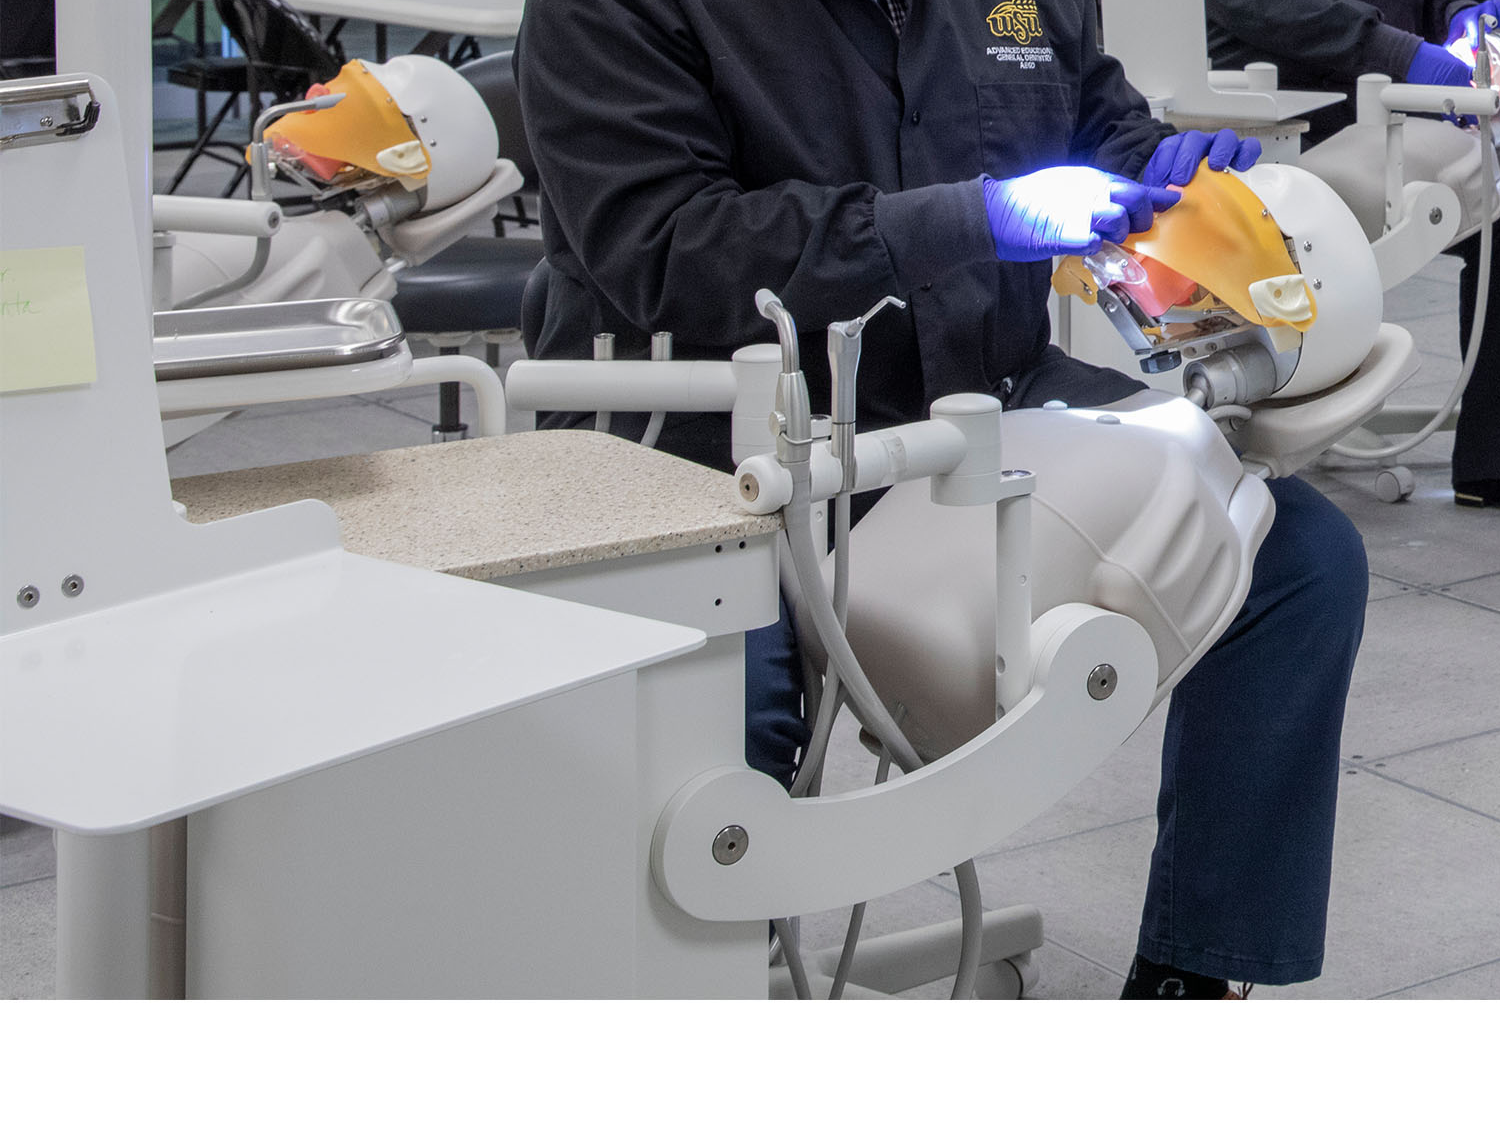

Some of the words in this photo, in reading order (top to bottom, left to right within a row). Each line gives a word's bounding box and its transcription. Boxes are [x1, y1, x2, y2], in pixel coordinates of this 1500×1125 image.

[986, 8, 1043, 45] WSU
[986, 46, 1020, 55] ADVANCED
[996, 54, 1024, 62] GENERAL
